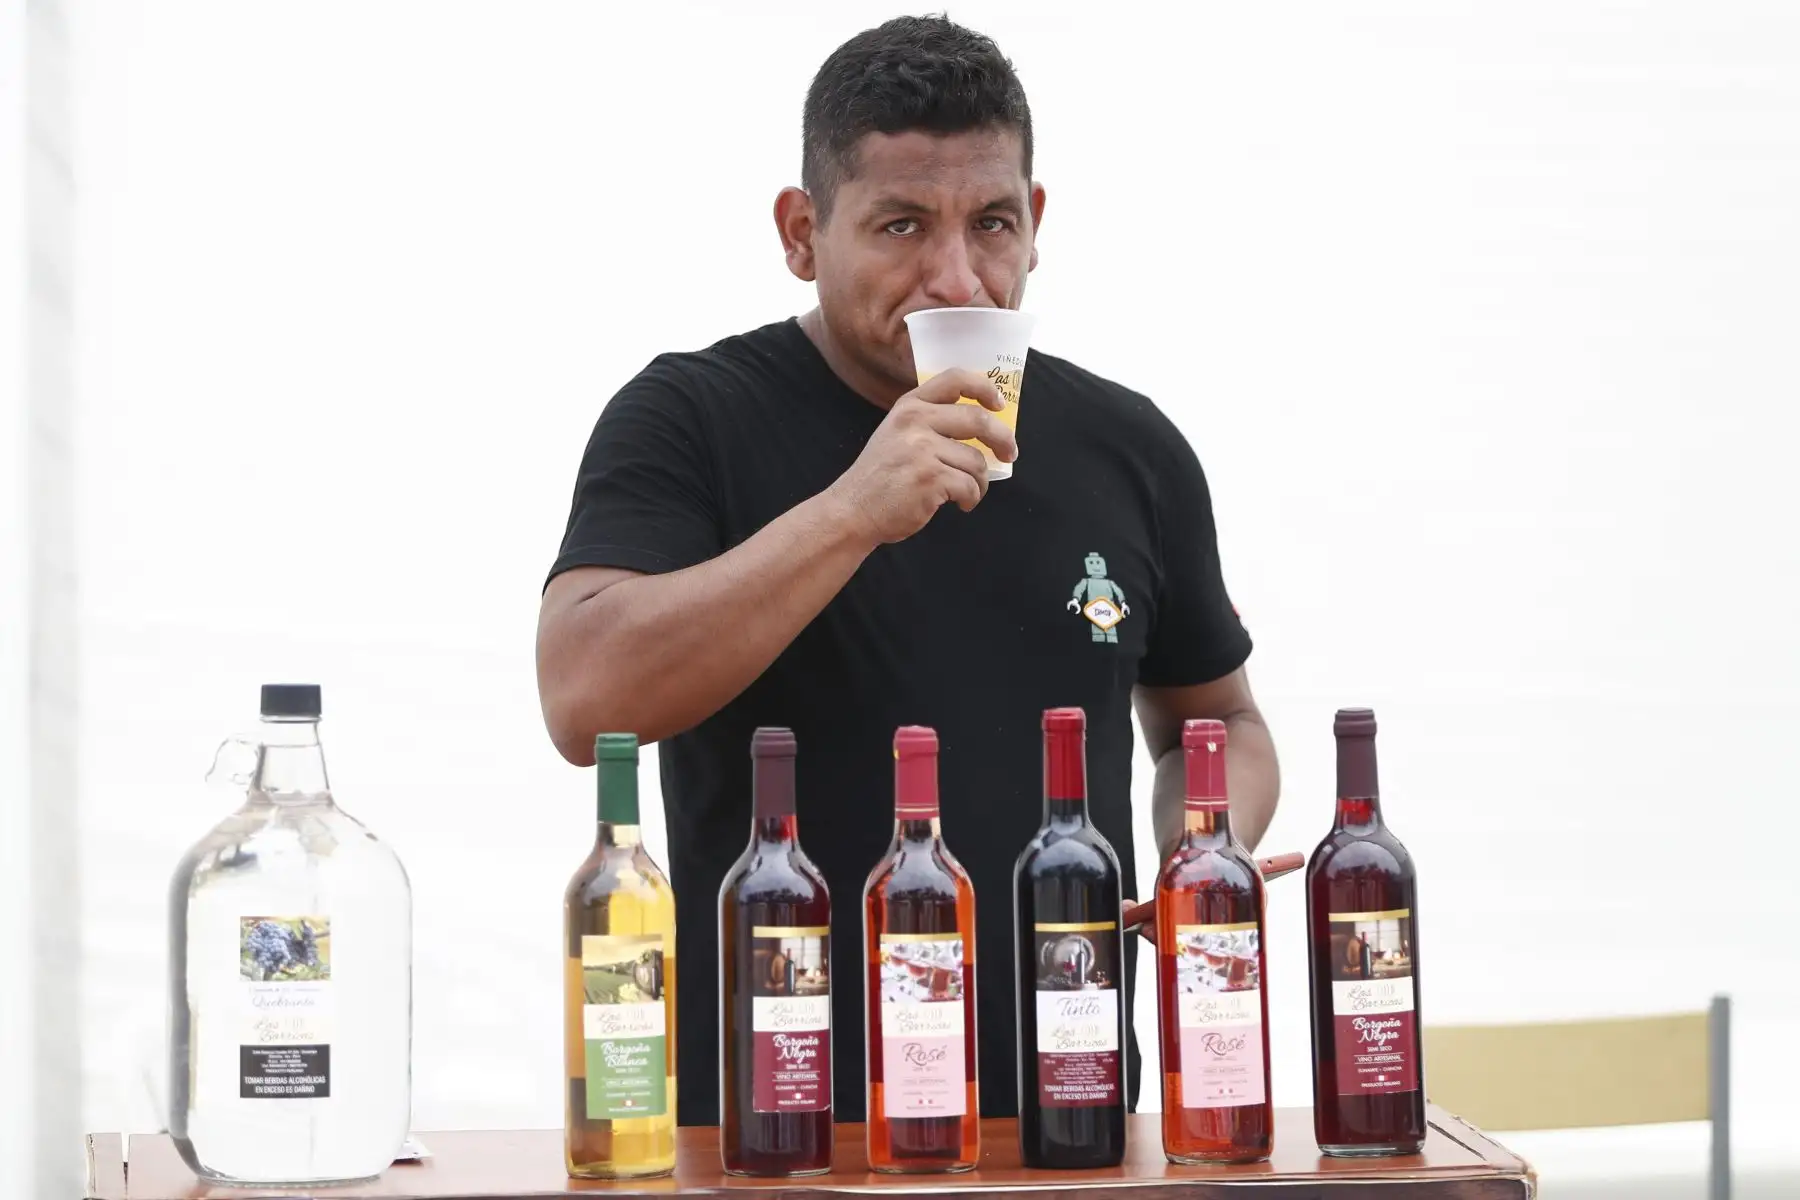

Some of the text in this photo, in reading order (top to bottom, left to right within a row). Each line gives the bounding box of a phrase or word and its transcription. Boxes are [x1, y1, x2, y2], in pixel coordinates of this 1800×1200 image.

[987, 366, 1010, 384] Las
[1056, 996, 1100, 1016] Tinto
[1352, 1016, 1402, 1032] Borgoña
[772, 1034, 819, 1049] Borgoña
[1201, 1032, 1246, 1056] Rosé
[1357, 1029, 1400, 1046] Negra
[776, 1046, 816, 1064] Negra
[902, 1042, 948, 1066] Rosé
[244, 1075, 326, 1084] TOMAR BEBIDAS ALCOHÓLICAS
[256, 1086, 264, 1094] EN
[264, 1086, 285, 1094] EXCESO
[1044, 1084, 1062, 1092] TOMAR
[1063, 1084, 1084, 1092] BEBIDAS
[1062, 1092, 1082, 1100] EXCESO
